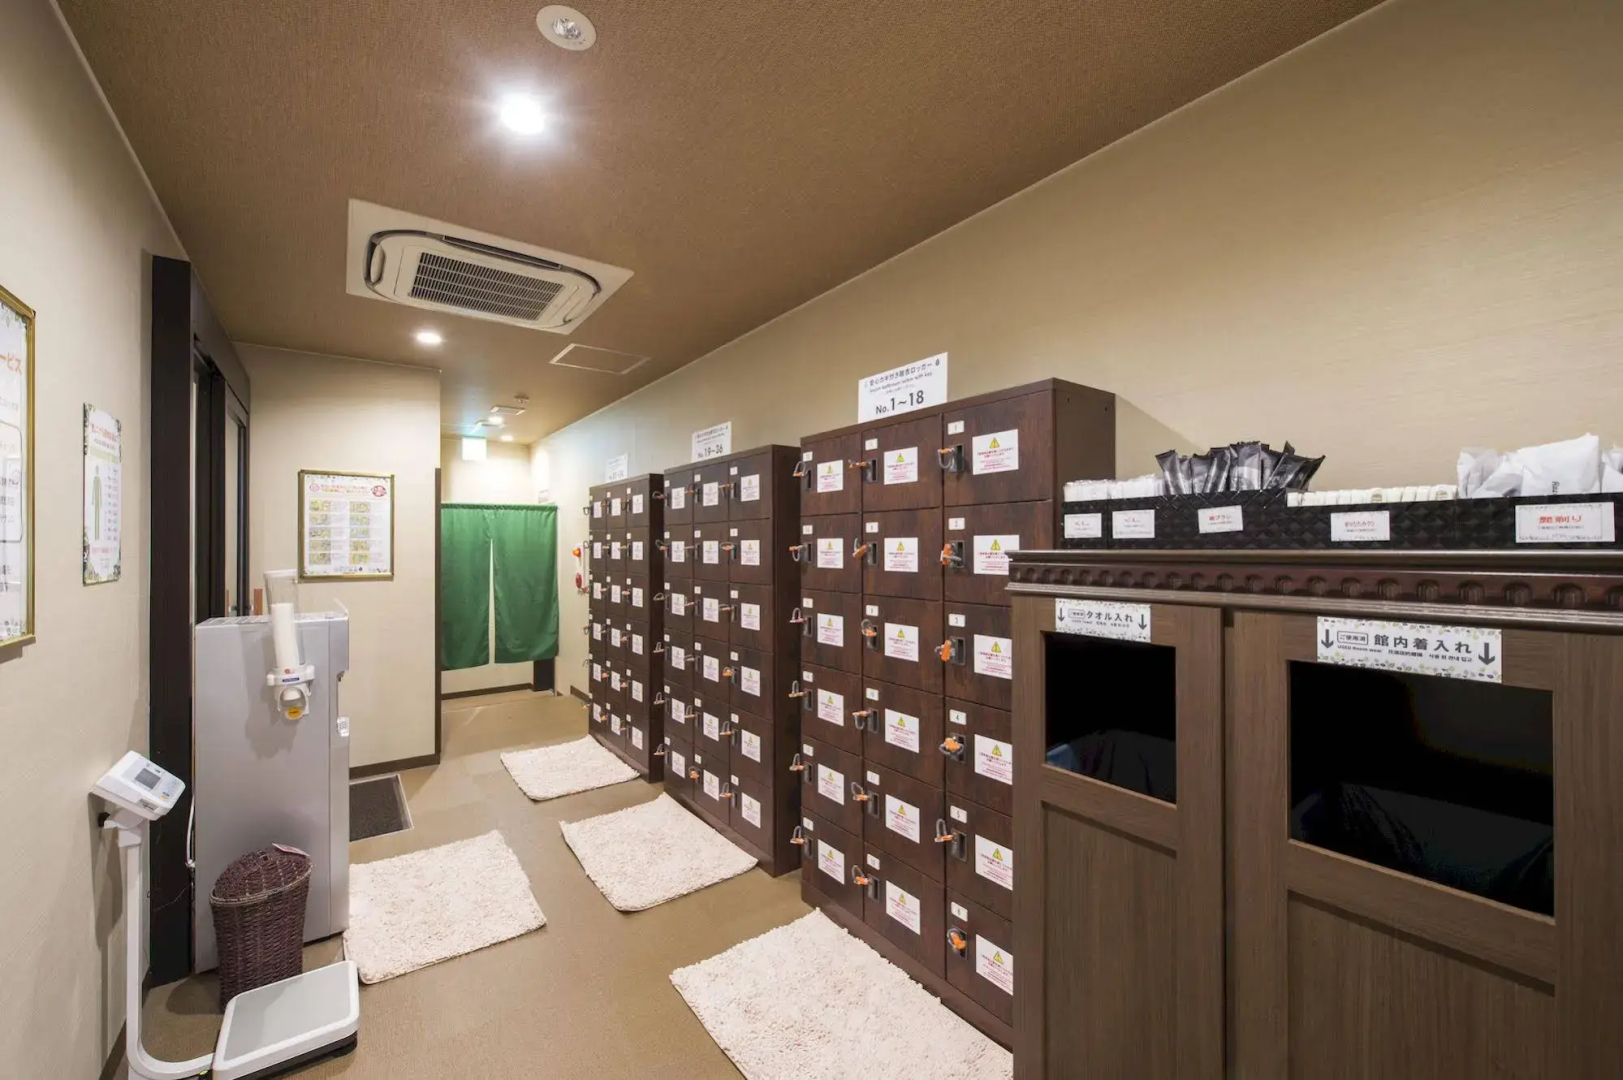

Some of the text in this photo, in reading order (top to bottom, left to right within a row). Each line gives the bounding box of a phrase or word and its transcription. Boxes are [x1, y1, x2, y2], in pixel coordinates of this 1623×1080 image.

[1086, 610, 1133, 623] タオル入れ
[1338, 633, 1472, 654] ご使用済 館内着入れ
